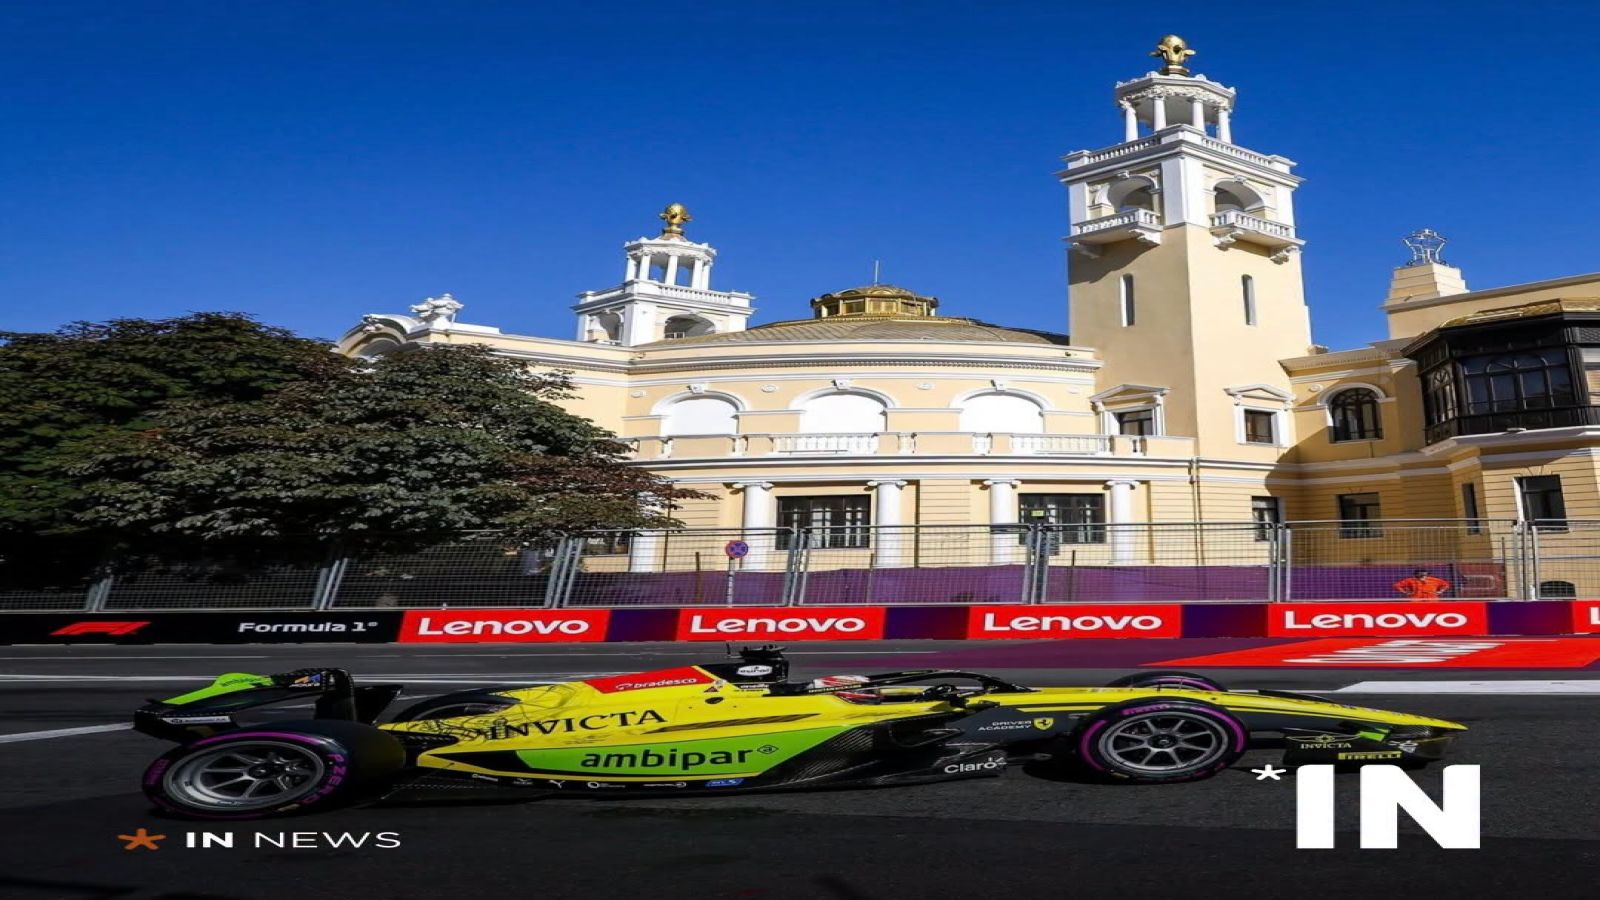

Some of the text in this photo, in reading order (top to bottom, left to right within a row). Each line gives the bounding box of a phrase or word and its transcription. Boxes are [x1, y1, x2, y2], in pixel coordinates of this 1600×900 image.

[237, 621, 347, 634] Formula
[417, 617, 590, 637] Lenovo
[690, 615, 866, 635] Lenovo
[983, 612, 1163, 632] Lenovo
[1284, 610, 1468, 630] Lenovo
[633, 678, 697, 689] bradesco
[489, 709, 667, 741] INVICTA
[1300, 741, 1352, 750] INVICTA
[580, 749, 753, 770] ambipar
[944, 761, 998, 774] Claro
